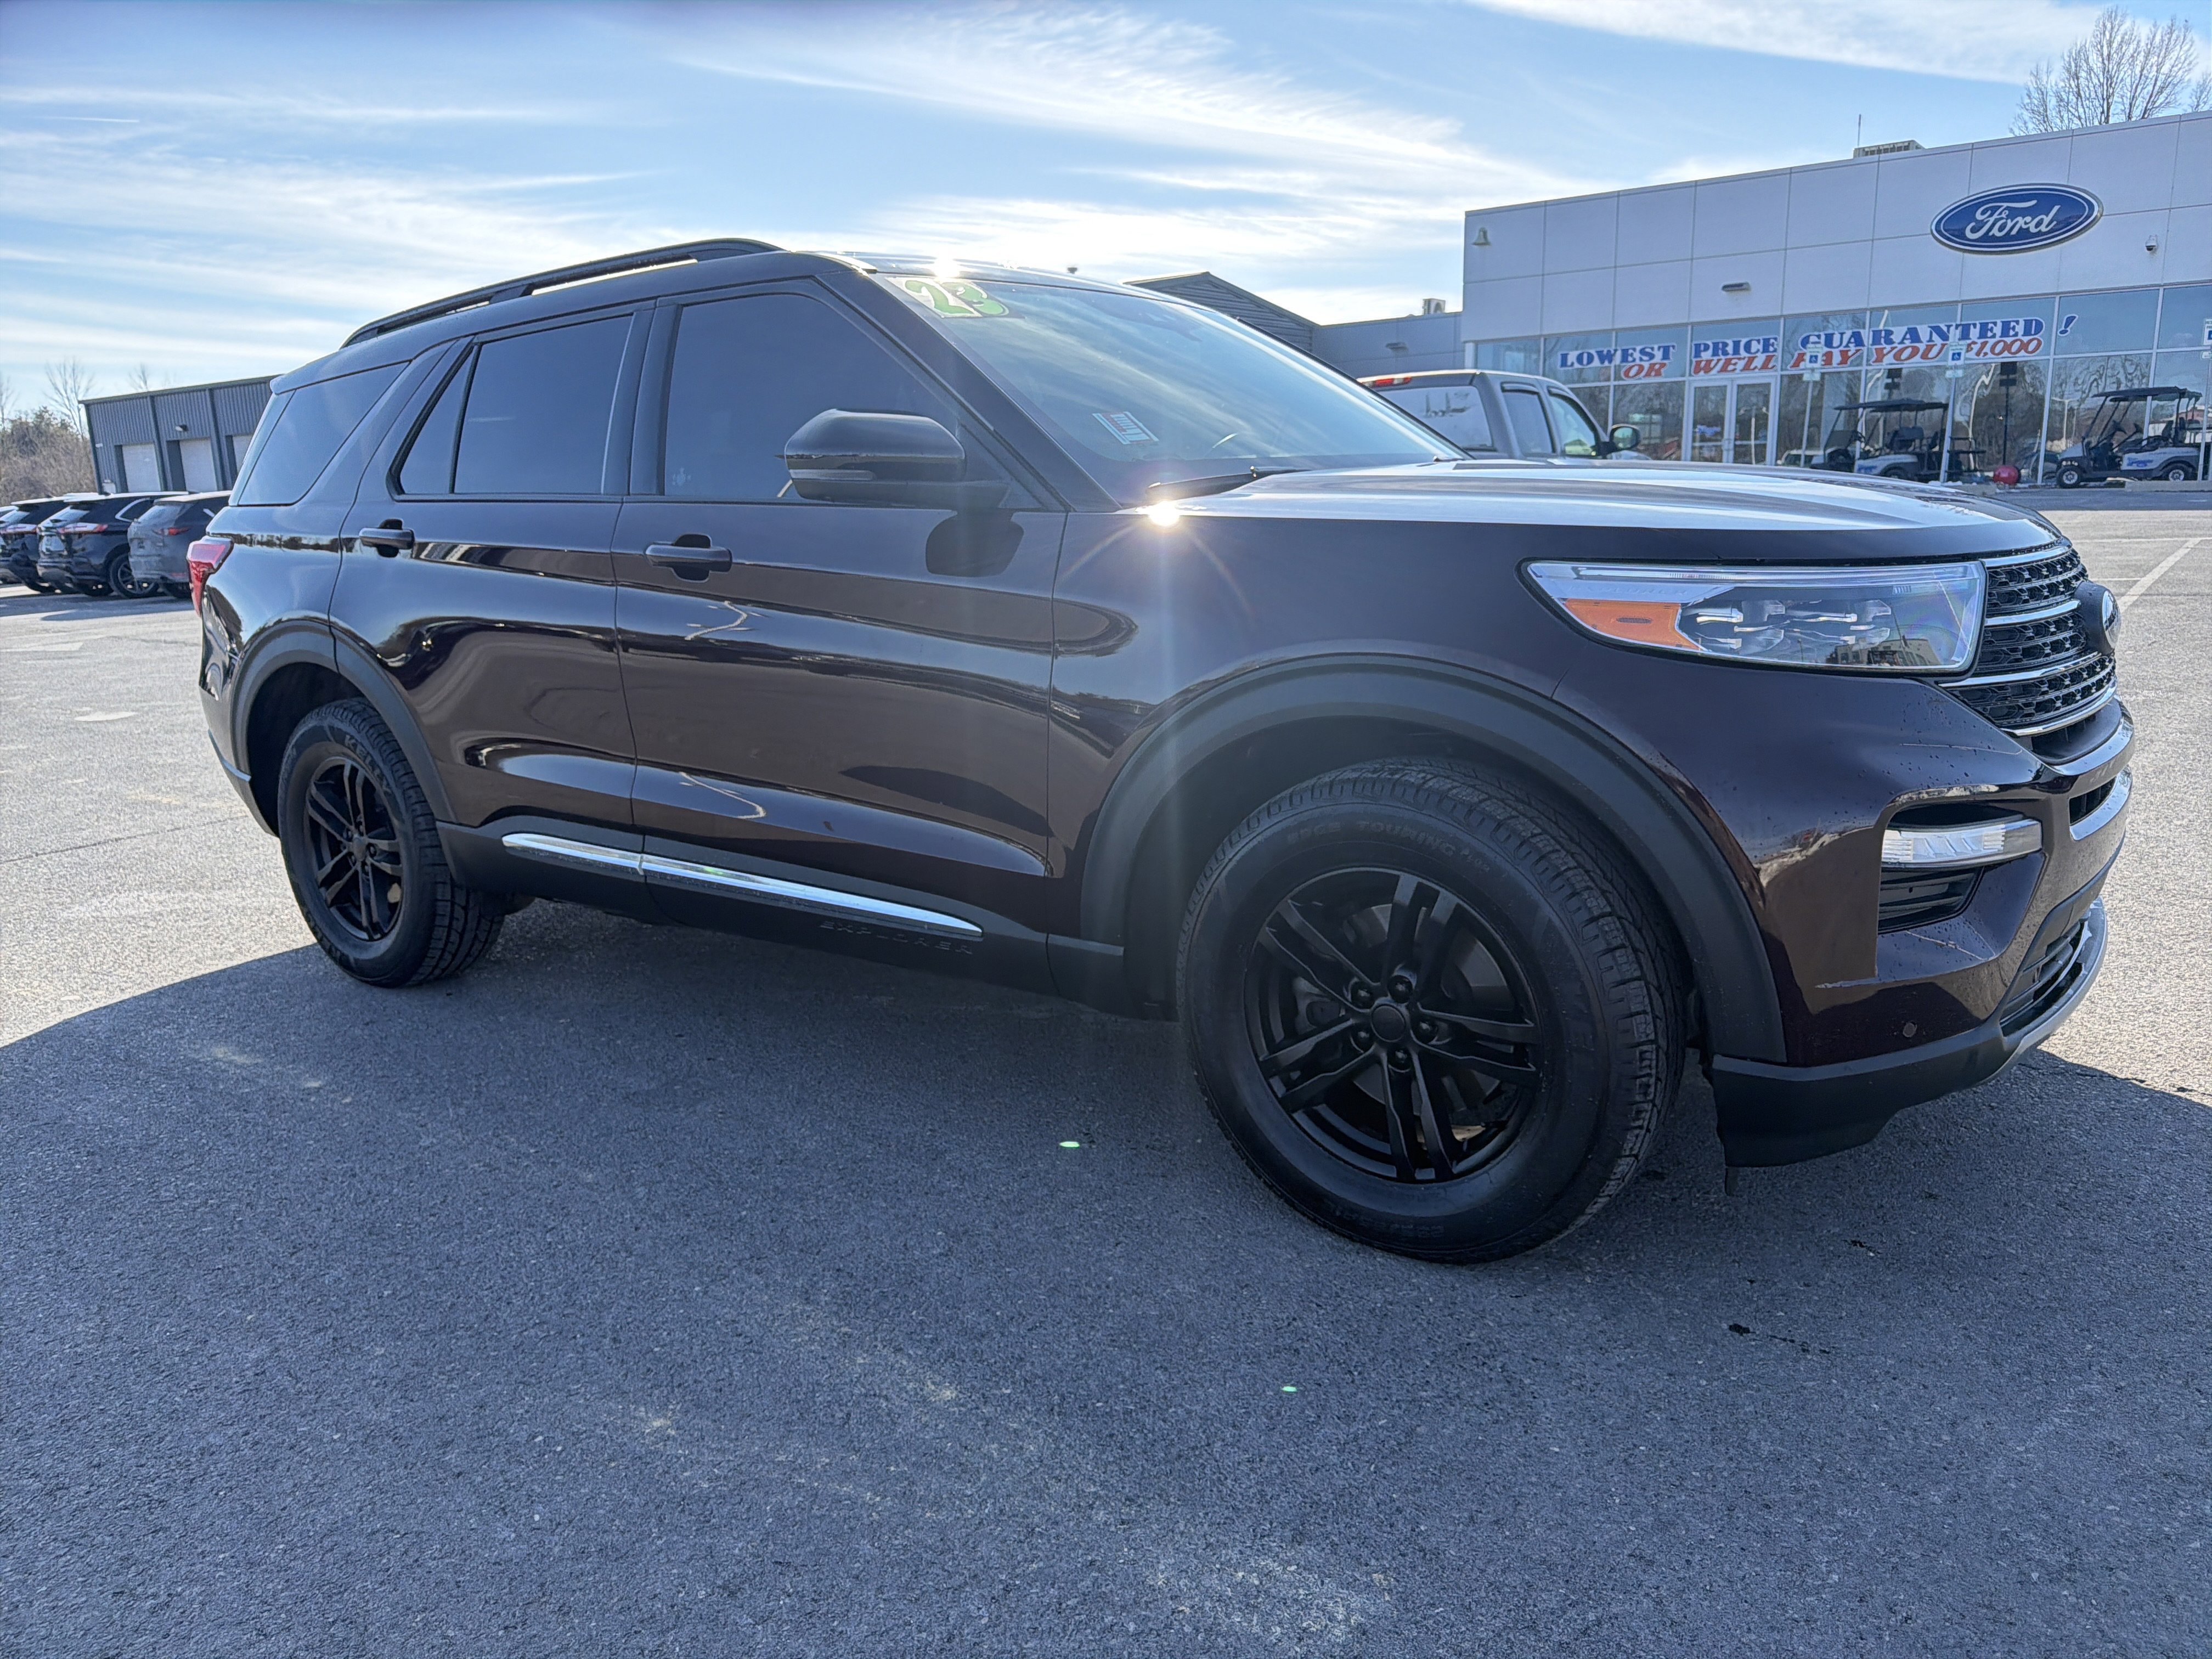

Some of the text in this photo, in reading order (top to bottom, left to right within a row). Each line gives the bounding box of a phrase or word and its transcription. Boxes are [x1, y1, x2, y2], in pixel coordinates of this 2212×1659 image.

[1965, 200, 2061, 239] Ford
[905, 280, 1009, 315] 23
[1560, 345, 1675, 368] LOWEST
[1693, 337, 1778, 358] PRICE
[1800, 319, 2044, 350] GUARANTEED
[1623, 363, 1667, 379] OR
[1872, 343, 1948, 363] YOU
